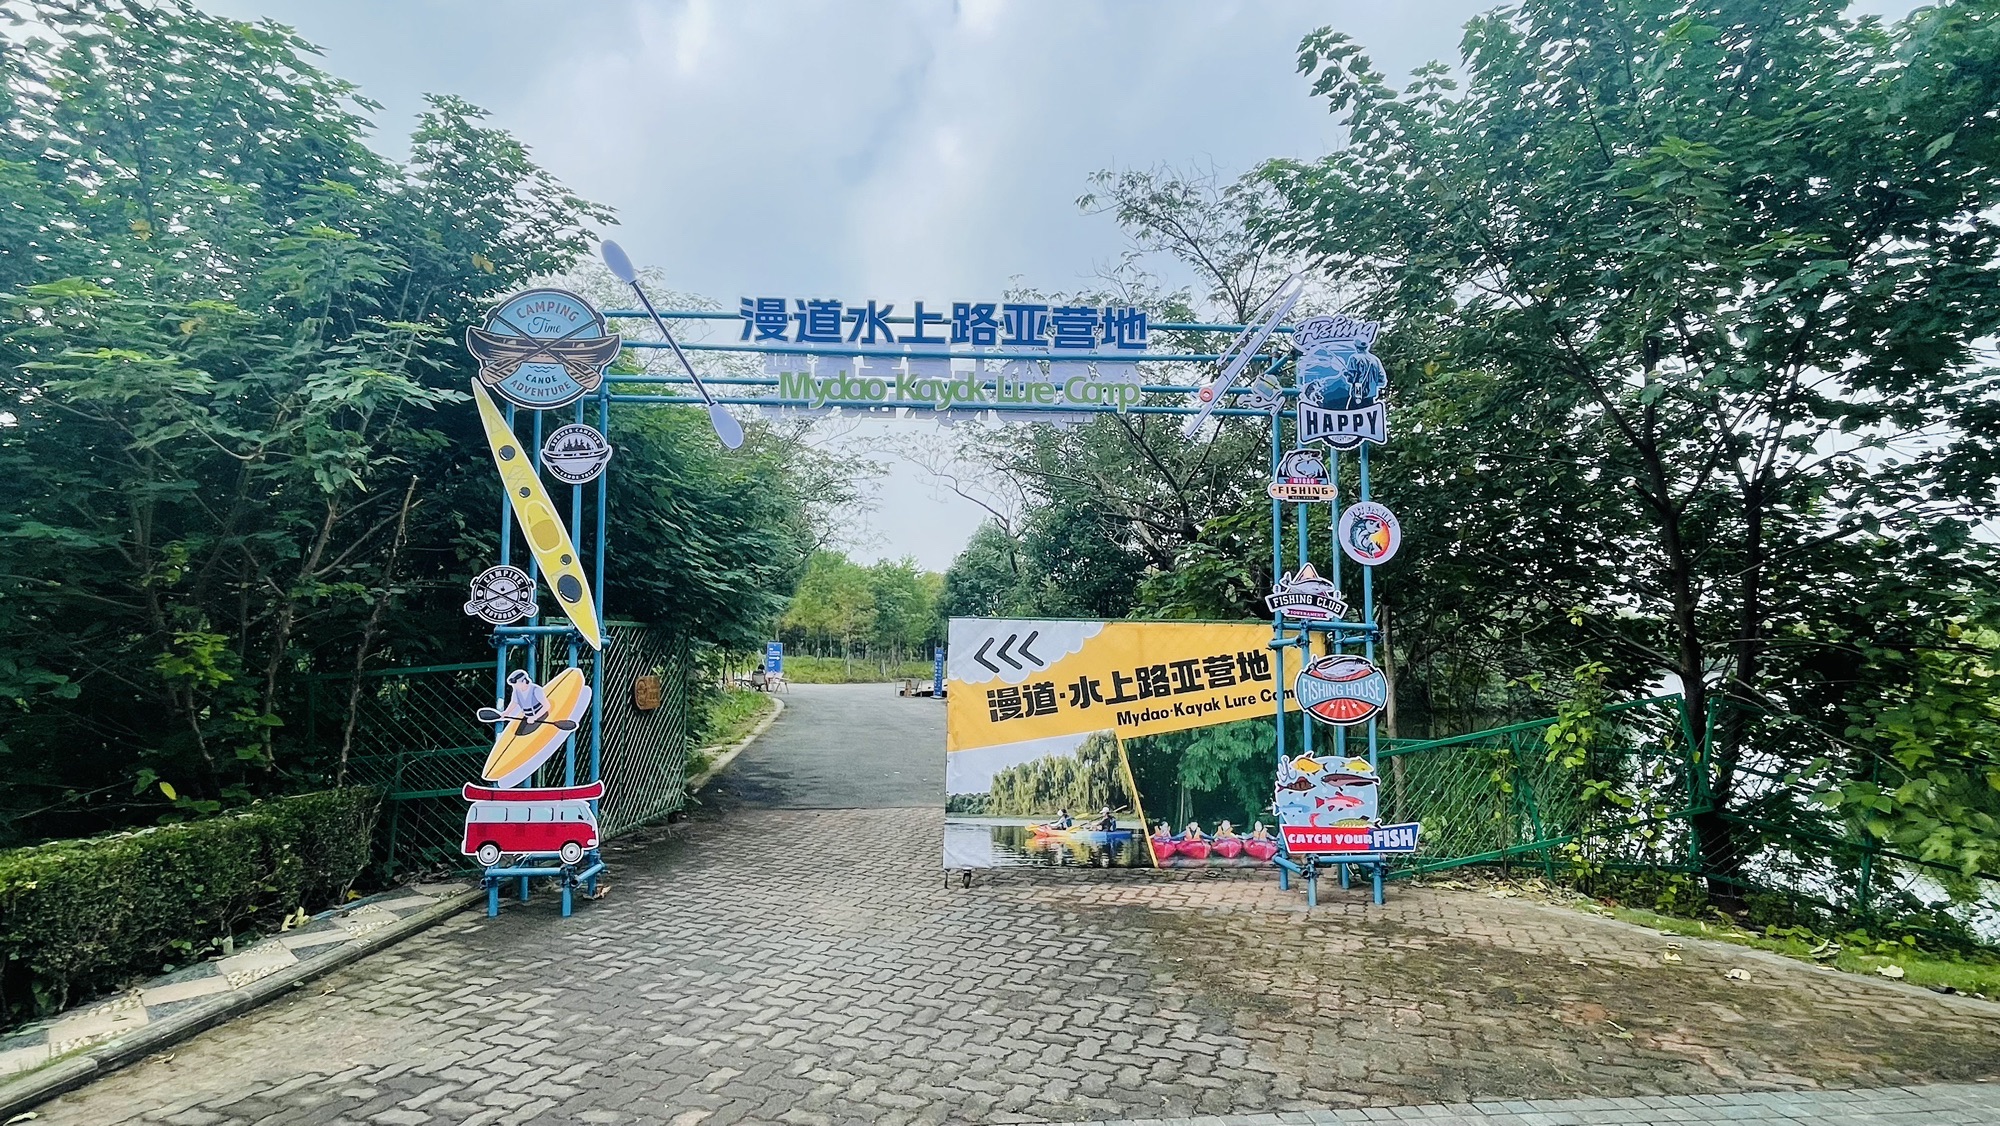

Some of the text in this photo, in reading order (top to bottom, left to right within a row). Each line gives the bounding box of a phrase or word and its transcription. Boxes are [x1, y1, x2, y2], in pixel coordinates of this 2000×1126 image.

[516, 301, 579, 322] CAMPING
[527, 317, 561, 334] Time
[740, 297, 1147, 349] 漫道水上路亚营地
[1294, 317, 1378, 345] Fishing
[510, 380, 571, 397] ADVENTURE
[525, 374, 557, 384] CANOE
[780, 371, 1141, 413] Mydao Kayak Lure Camp
[1306, 410, 1378, 435] HAPPY
[1278, 486, 1329, 495] FISHING
[483, 570, 524, 585] CAMPING
[1272, 594, 1342, 613] FISHING CLUB
[484, 608, 517, 619] OUTDOOR
[1302, 676, 1381, 704] FISHING HOUSE
[1224, 694, 1257, 709] Lure
[1287, 828, 1414, 848] CATCH YOUR FISH
